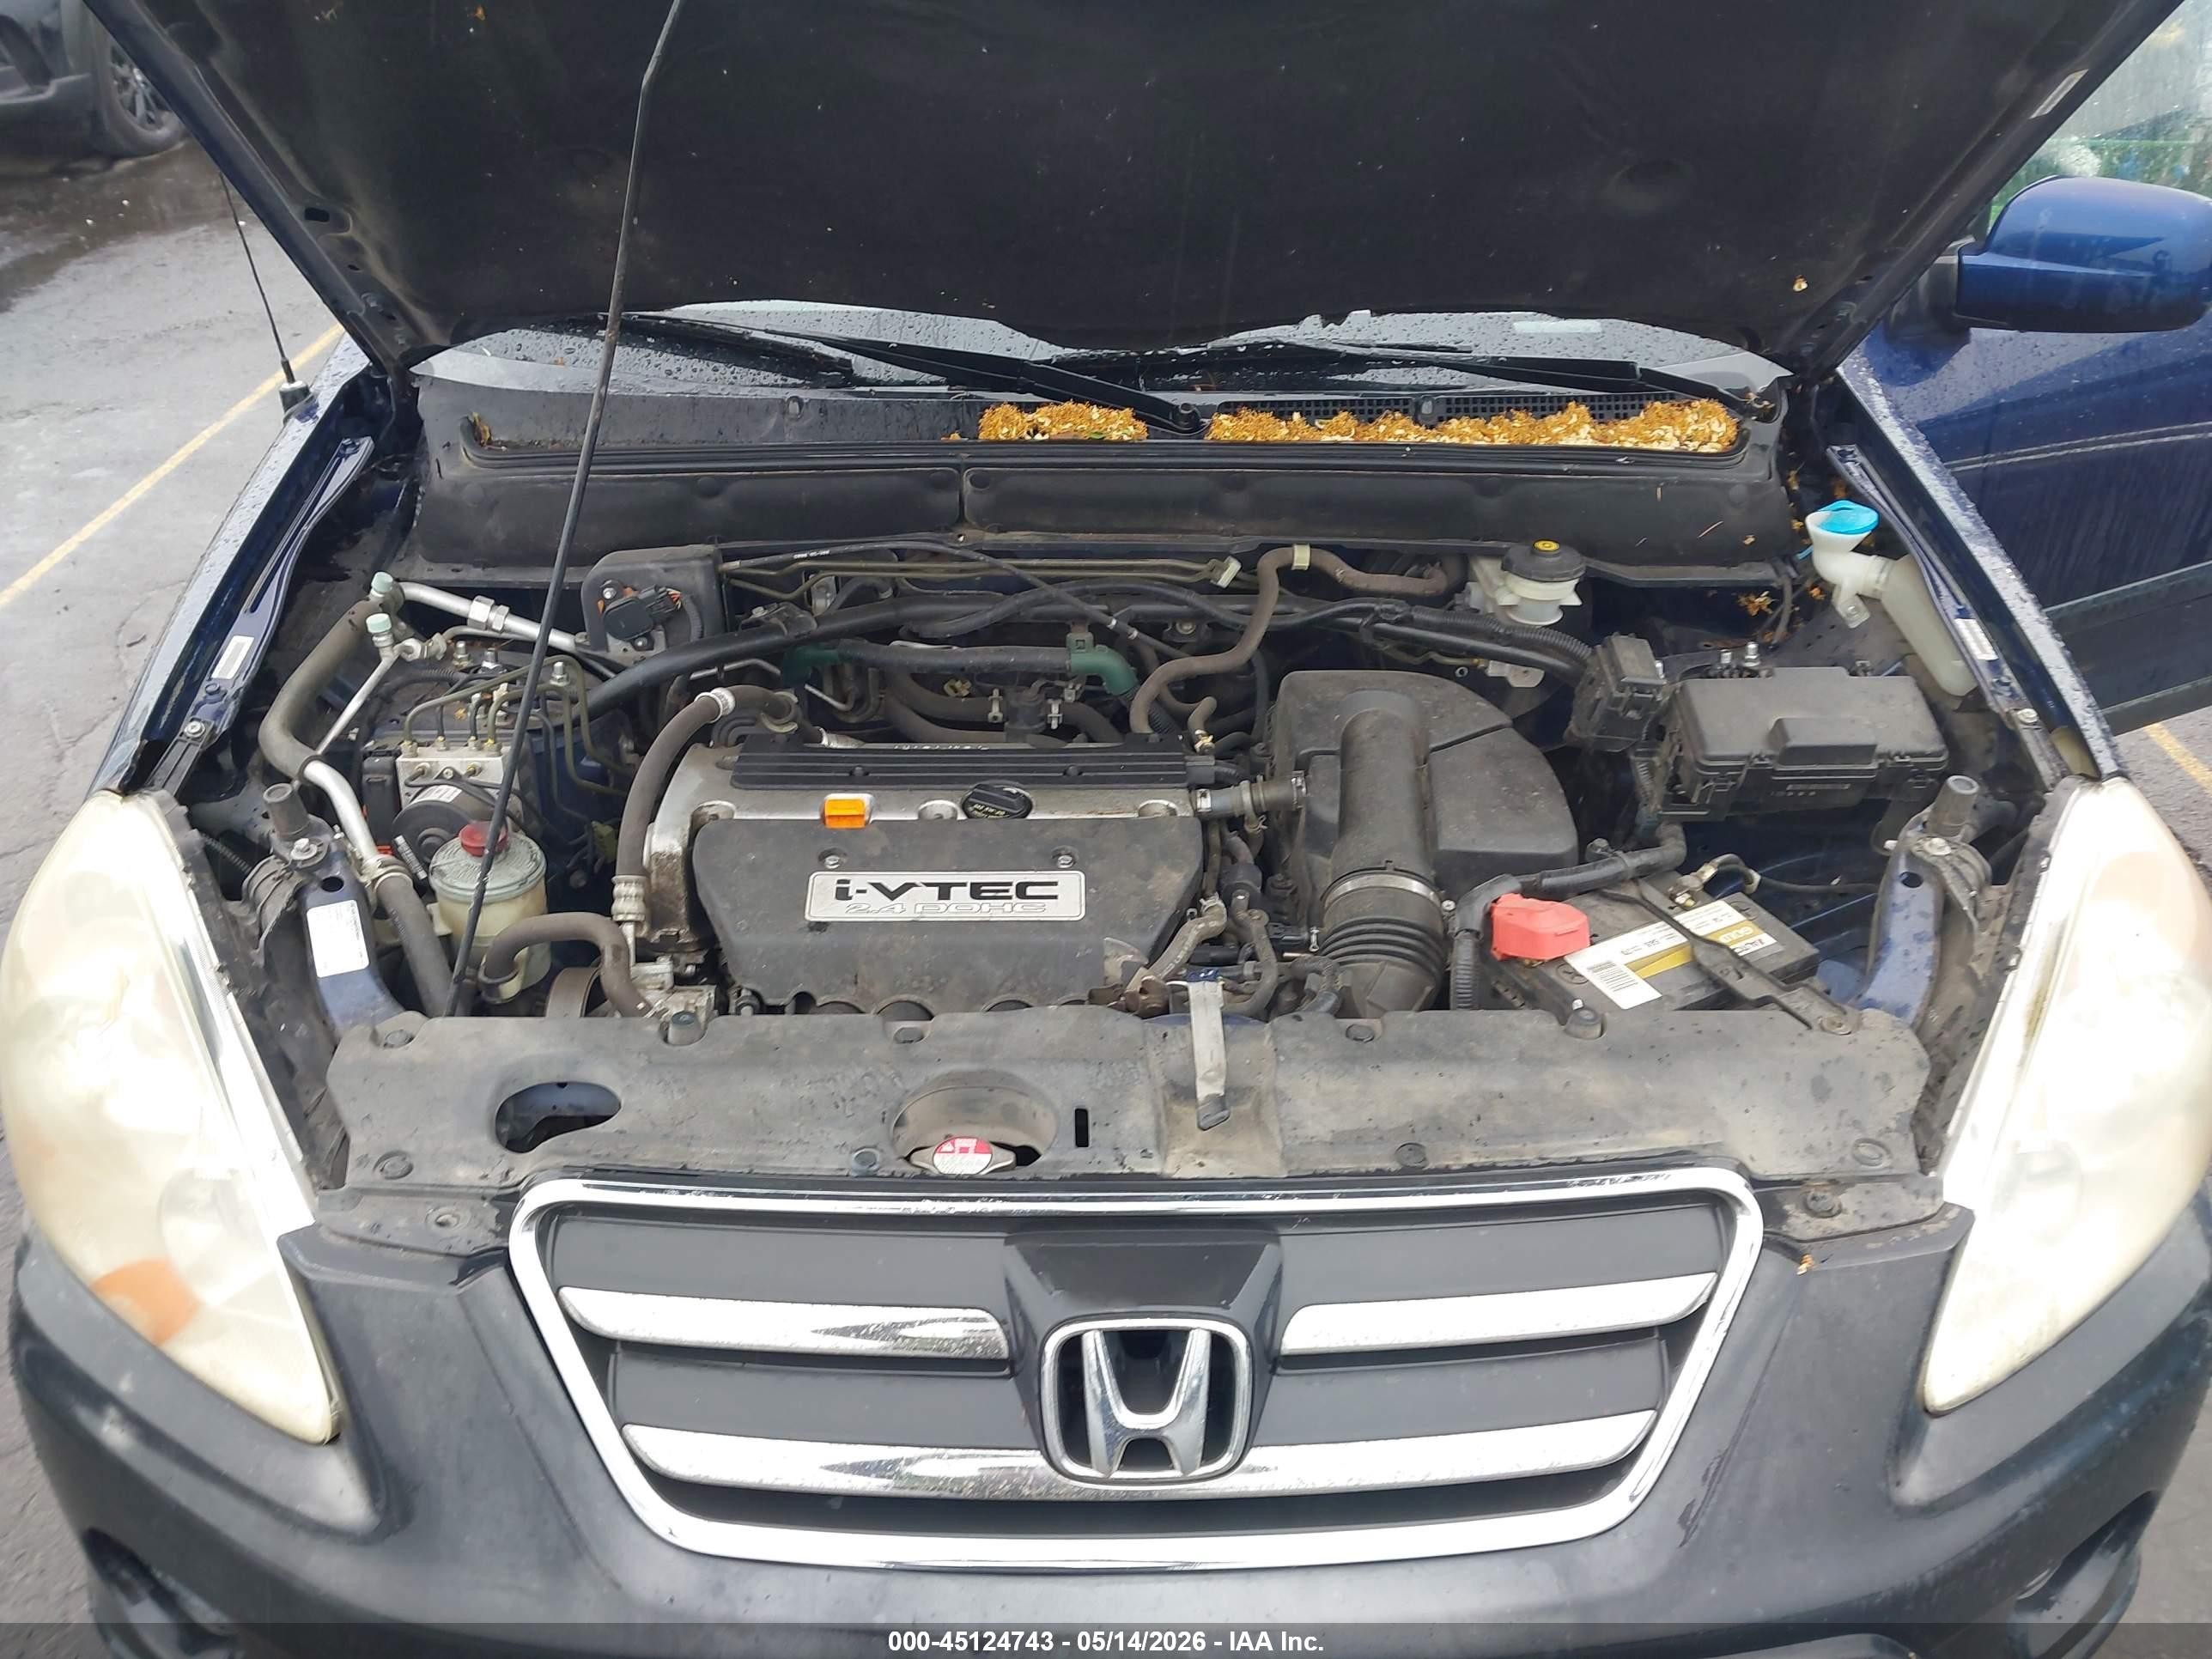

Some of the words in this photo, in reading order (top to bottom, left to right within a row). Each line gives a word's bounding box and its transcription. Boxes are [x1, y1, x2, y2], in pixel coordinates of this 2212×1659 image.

[834, 878, 1058, 902] i-VTEC
[844, 902, 907, 915] 2.4
[914, 902, 1047, 915] DOHC
